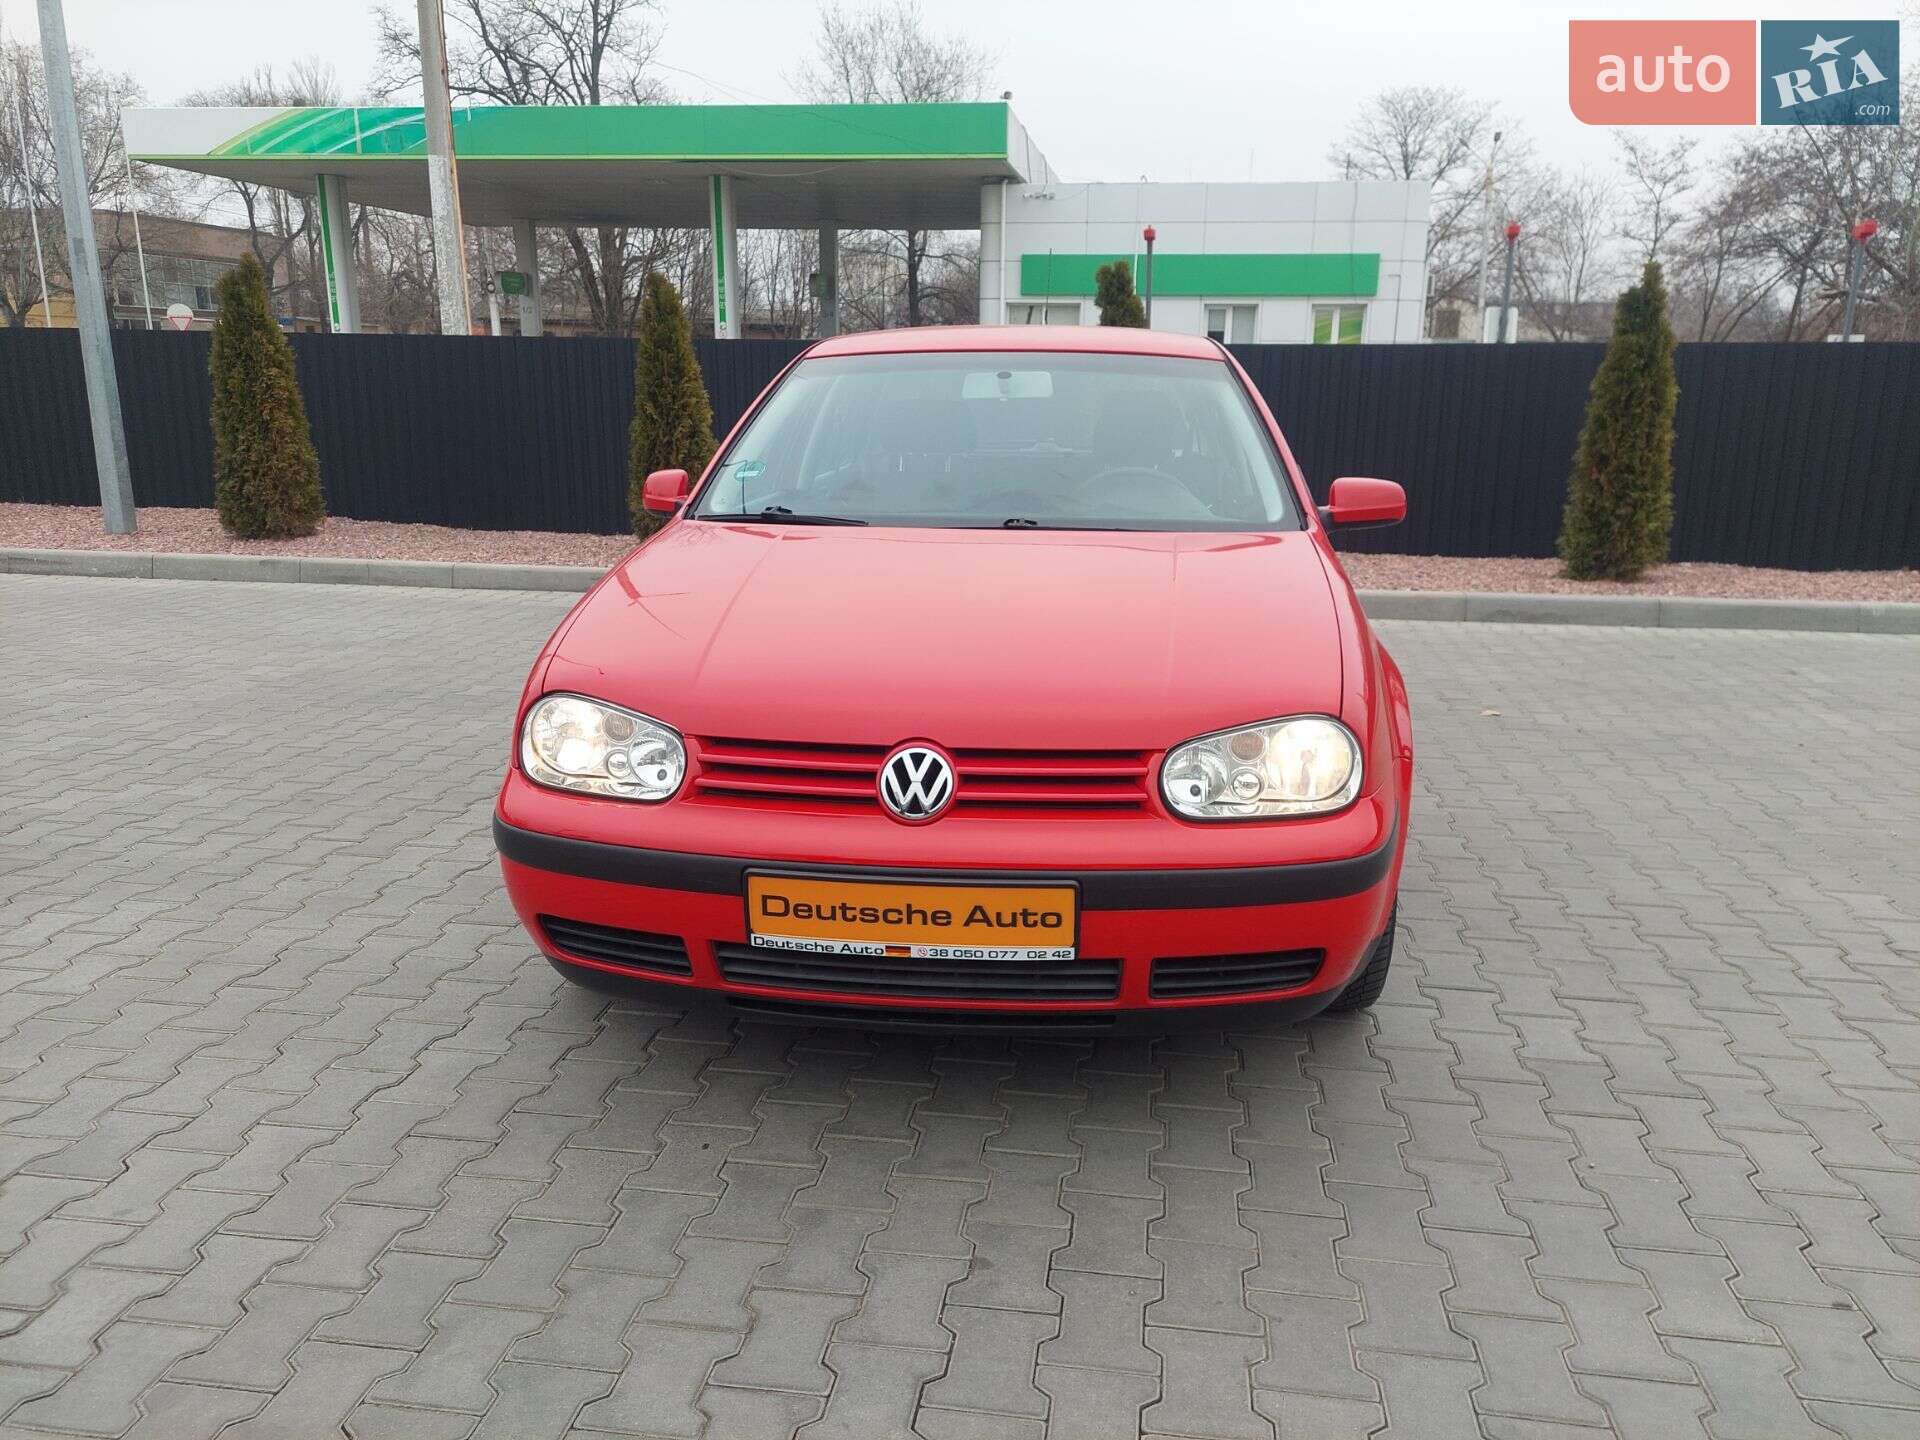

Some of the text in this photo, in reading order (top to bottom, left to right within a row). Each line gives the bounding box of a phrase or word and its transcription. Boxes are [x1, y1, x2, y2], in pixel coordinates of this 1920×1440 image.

[761, 894, 1063, 929] Deutsche Auto
[753, 935, 1071, 959] Deutsche Auto 38 050 077 02 42
